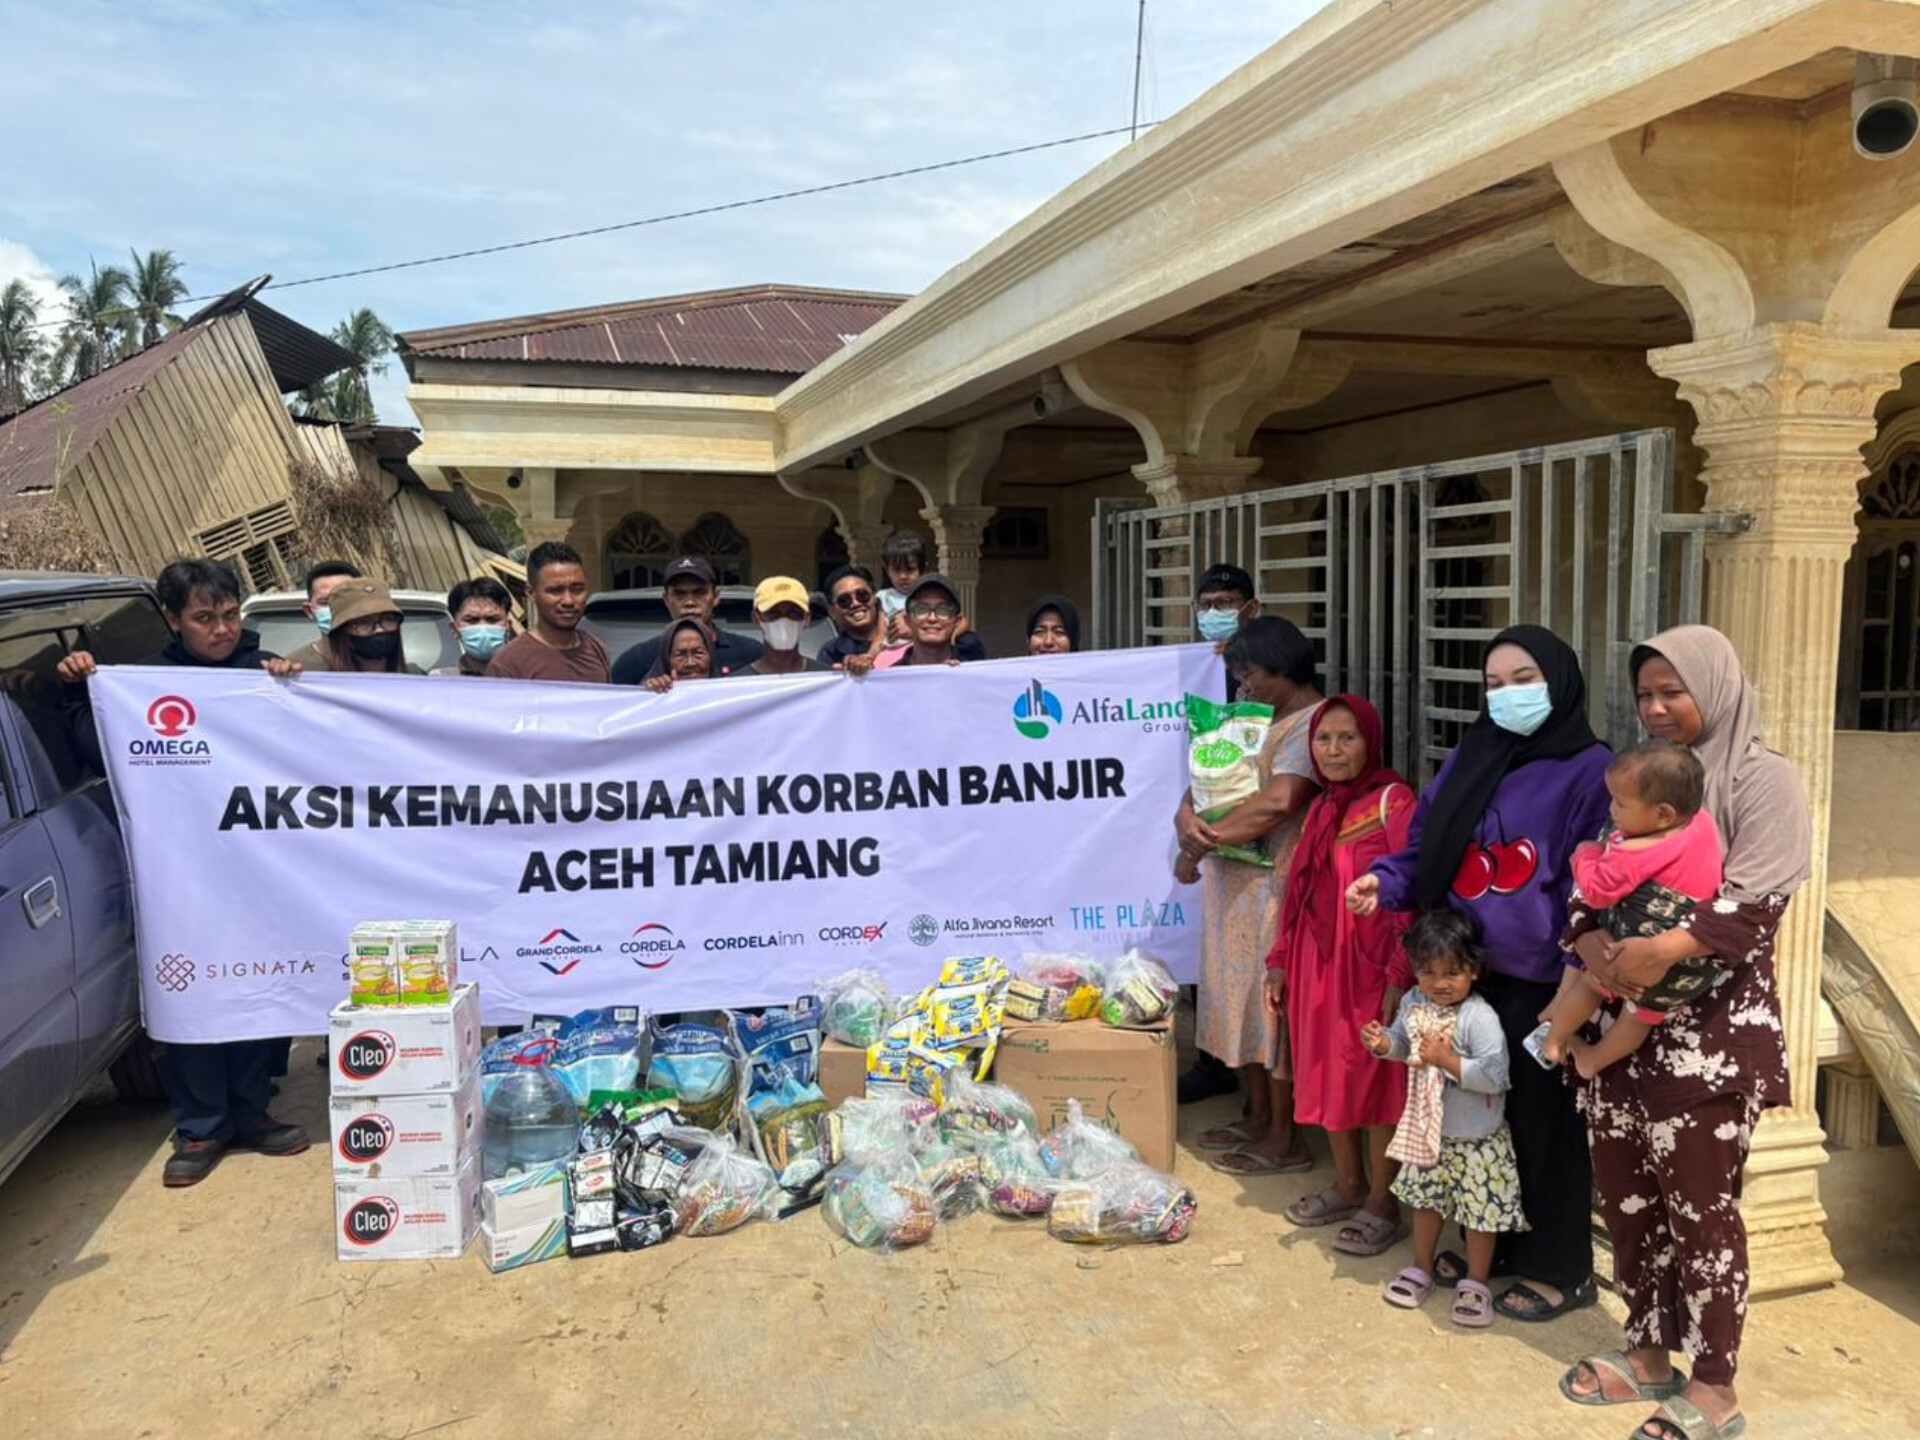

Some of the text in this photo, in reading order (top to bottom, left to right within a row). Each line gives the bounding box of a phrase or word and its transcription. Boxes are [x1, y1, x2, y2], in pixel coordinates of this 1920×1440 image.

[129, 740, 210, 755] OMEGA
[218, 757, 1127, 831] AKSI KEMANUSIAAN KORBAN BANJIR
[518, 837, 881, 893] ACEH TAMIANG
[943, 915, 1055, 931] Alfa Jivana Resort
[1070, 898, 1185, 930] THE PLAZA
[819, 921, 887, 942] CORDEX
[620, 939, 686, 954] CORDELA
[206, 960, 315, 979] SIGNATA
[350, 1045, 385, 1067] Cleo
[350, 1128, 384, 1149] Cleo
[354, 1210, 389, 1232] Cleo
